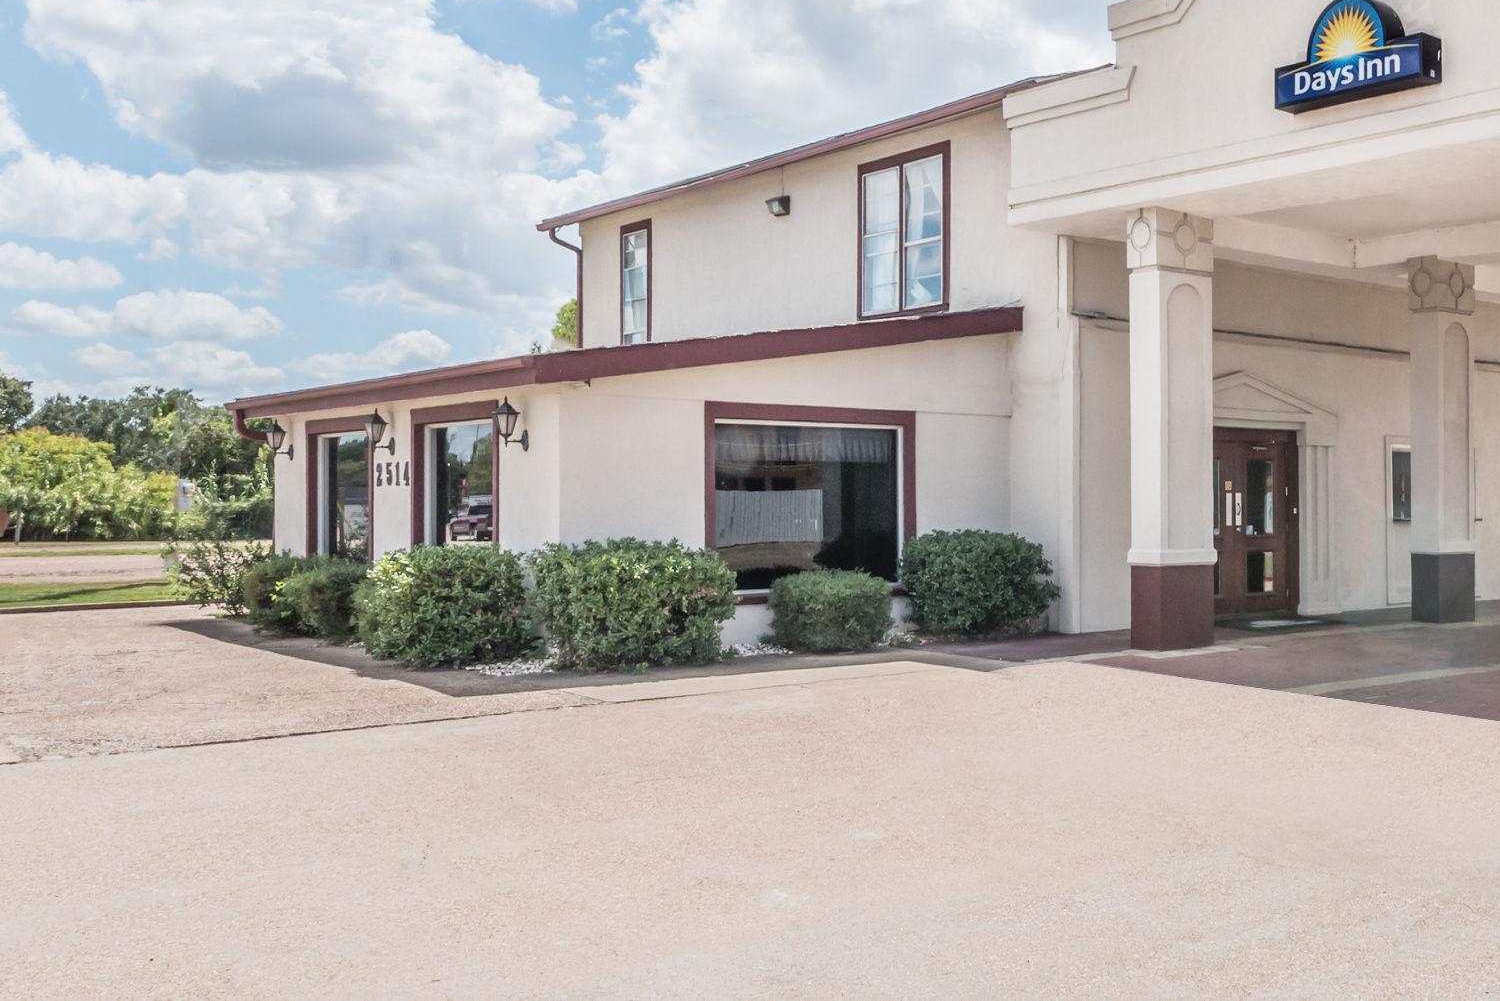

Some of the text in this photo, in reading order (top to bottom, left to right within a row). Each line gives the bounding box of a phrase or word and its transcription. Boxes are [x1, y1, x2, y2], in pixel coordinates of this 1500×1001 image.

[1294, 53, 1401, 95] Days Inn
[375, 461, 410, 487] 2514
